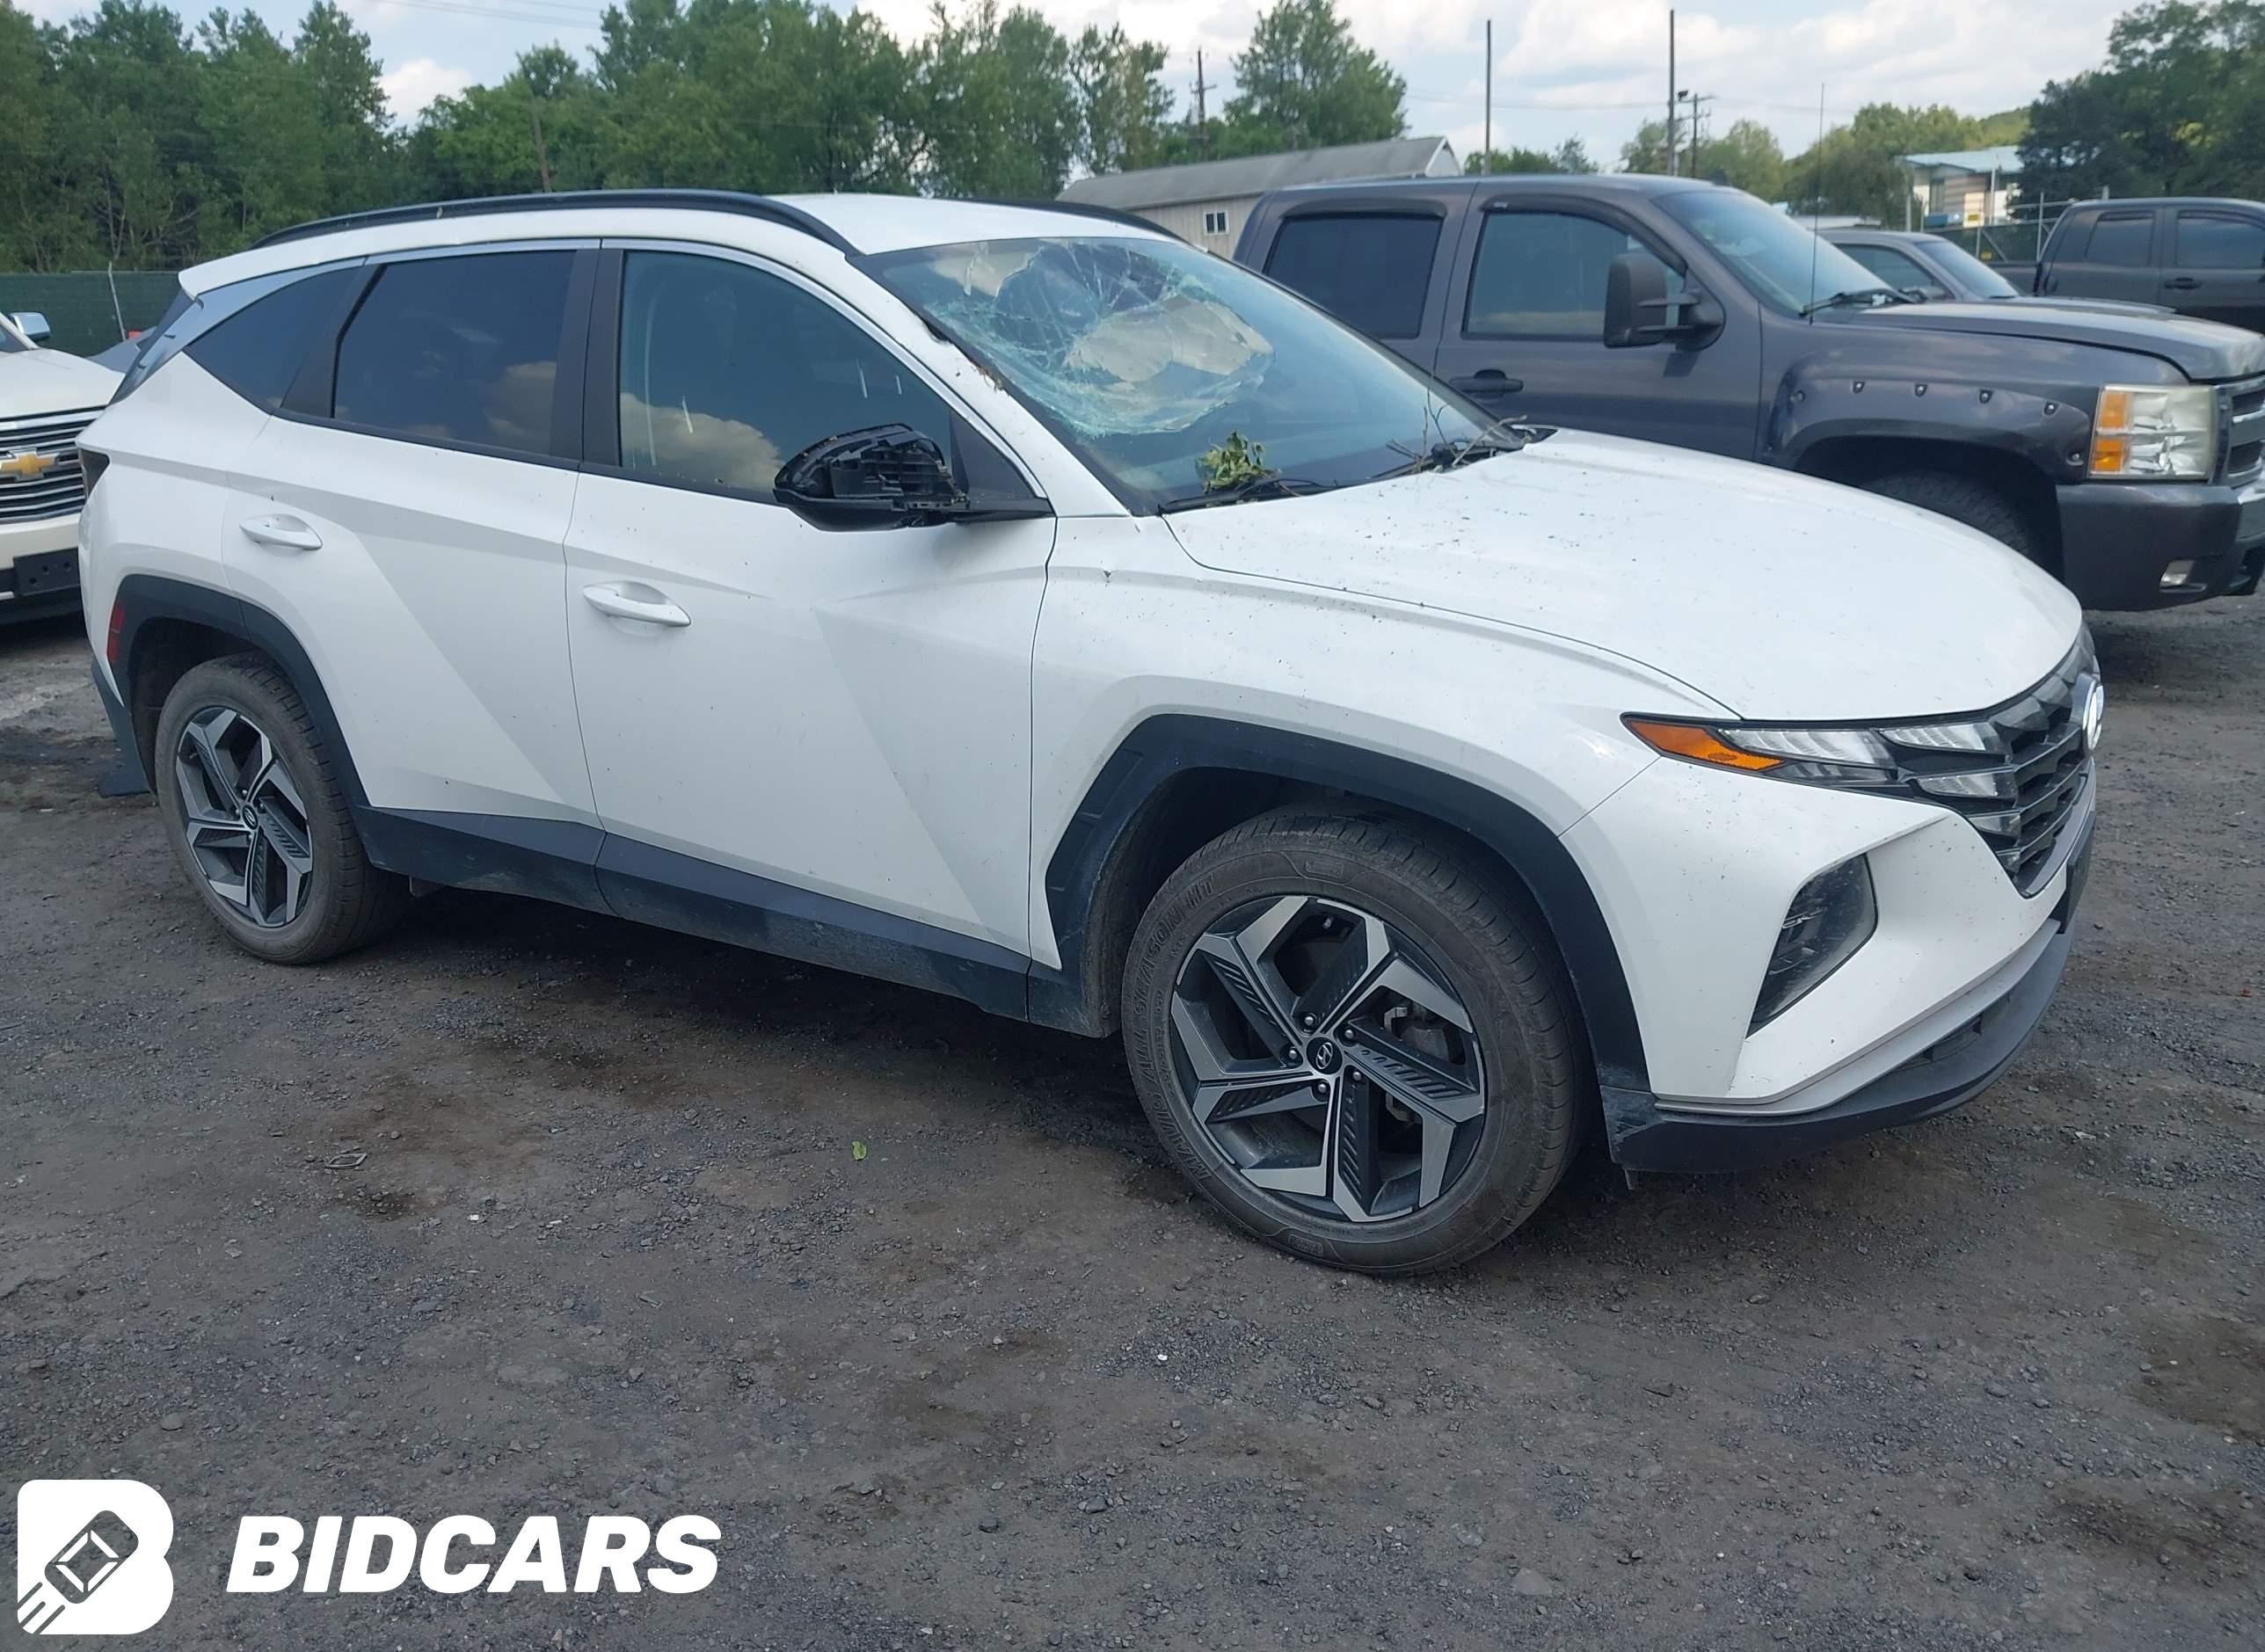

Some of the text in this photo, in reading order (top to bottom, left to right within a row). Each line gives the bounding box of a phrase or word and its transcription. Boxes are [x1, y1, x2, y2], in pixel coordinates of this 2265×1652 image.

[1186, 873, 1215, 909] HT
[1133, 899, 1184, 1015] SEASON
[1132, 1028, 1158, 1085] ALL
[1152, 1091, 1213, 1181] MAVIS
